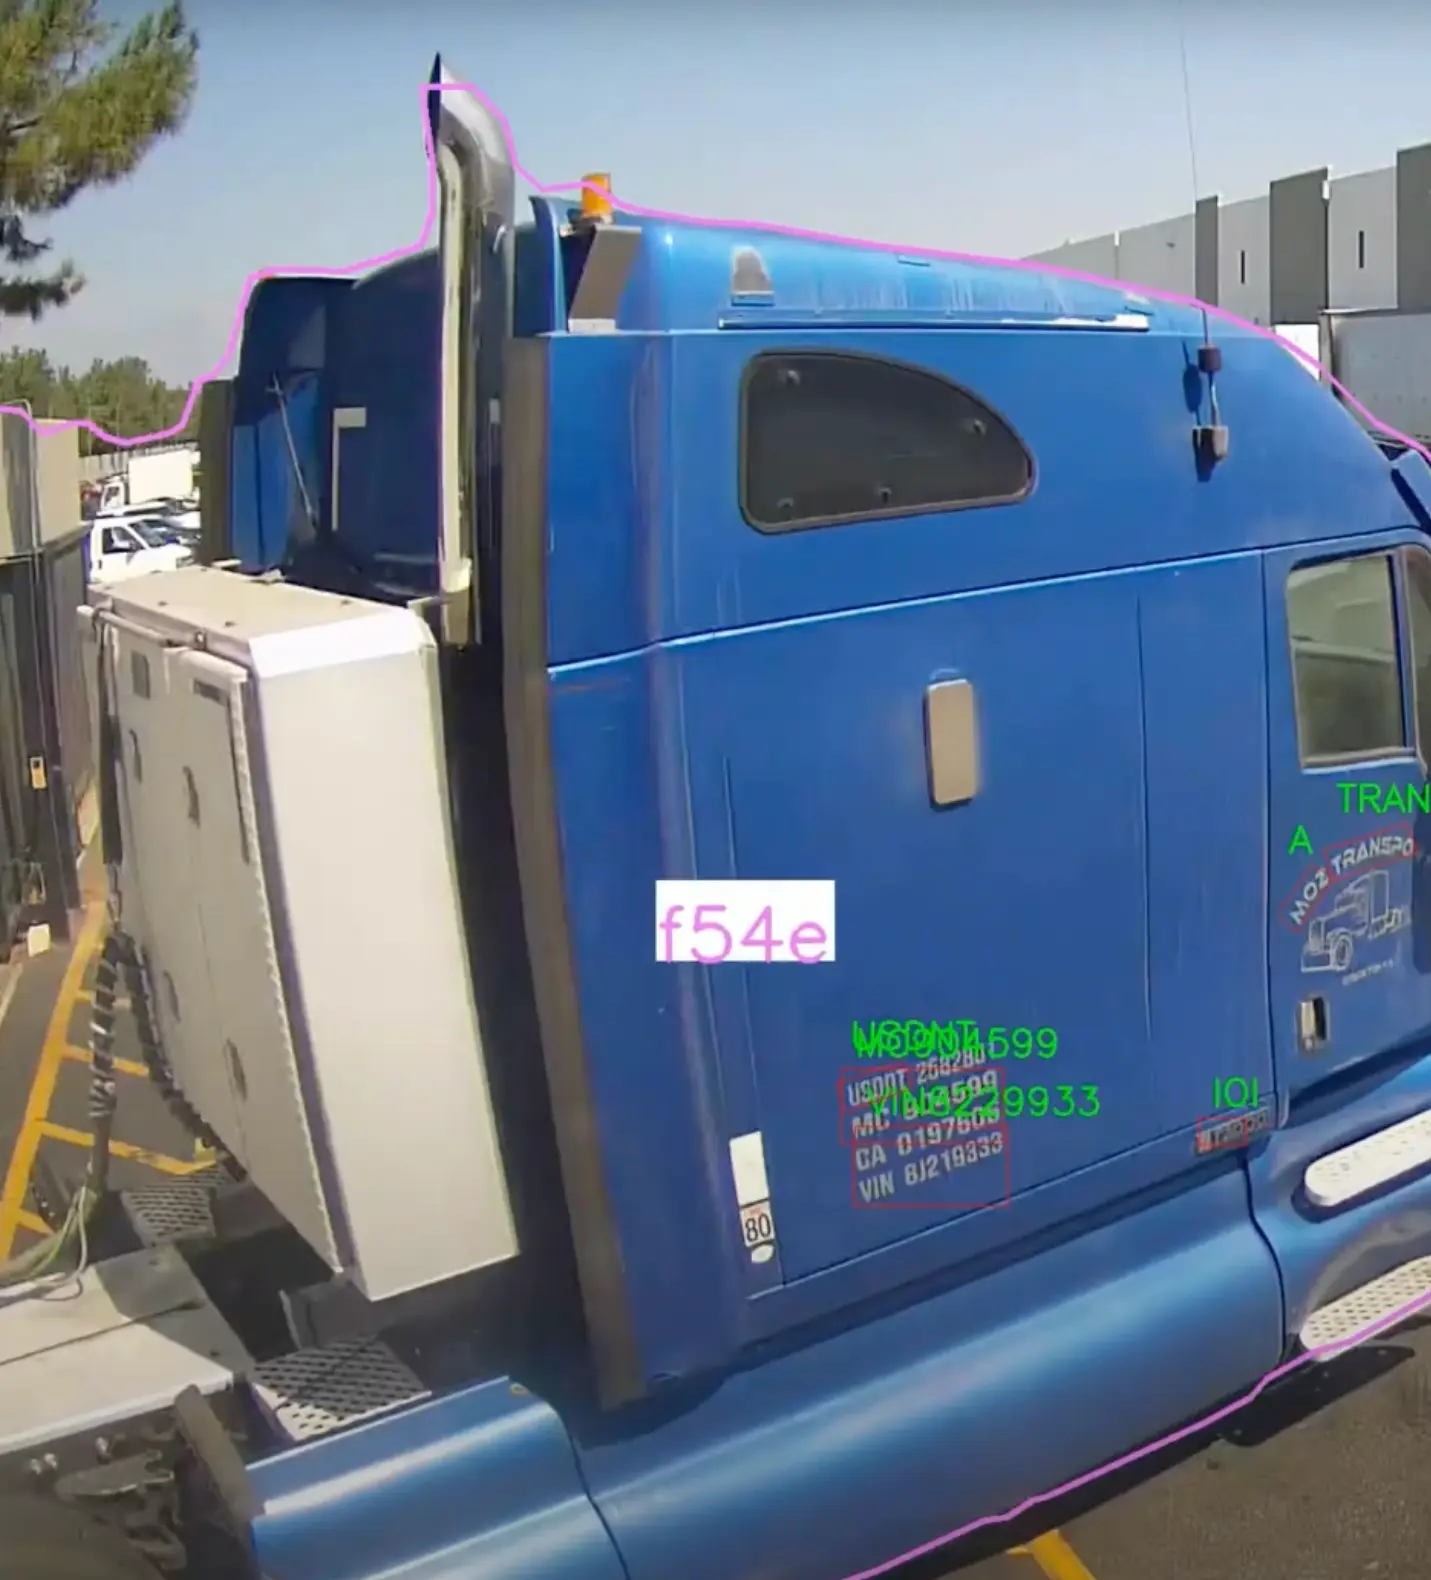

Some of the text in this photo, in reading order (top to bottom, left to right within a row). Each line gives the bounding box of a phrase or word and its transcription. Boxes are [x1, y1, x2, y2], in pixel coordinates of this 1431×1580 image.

[1289, 867, 1329, 925] MOZ
[855, 1144, 887, 1172] CA
[858, 1169, 896, 1203] VIN
[745, 1213, 770, 1243] 80
